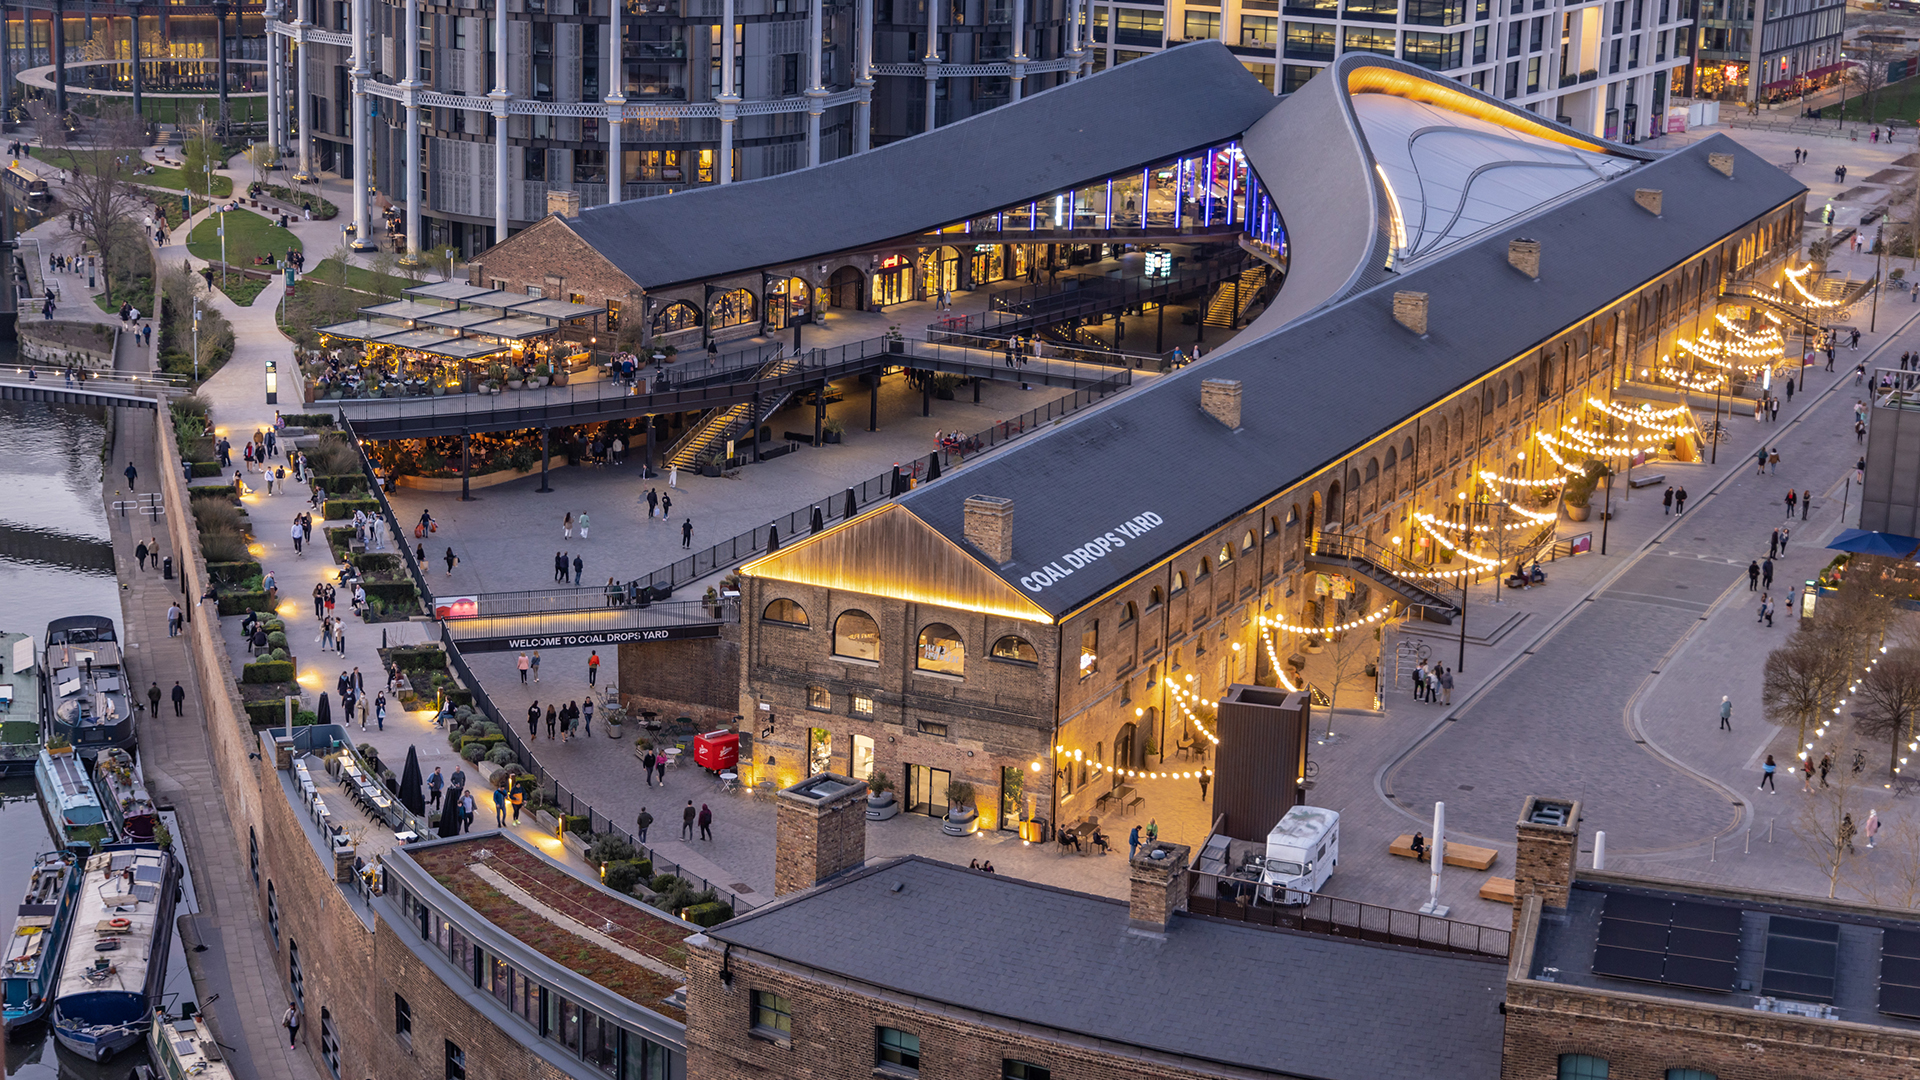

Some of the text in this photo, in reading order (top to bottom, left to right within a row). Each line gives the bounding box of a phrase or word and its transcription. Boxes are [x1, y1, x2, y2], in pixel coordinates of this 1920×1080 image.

[1020, 511, 1164, 593] COAL DROPS YARD
[509, 630, 669, 648] WELCOME TO COAL DROPS YARD
